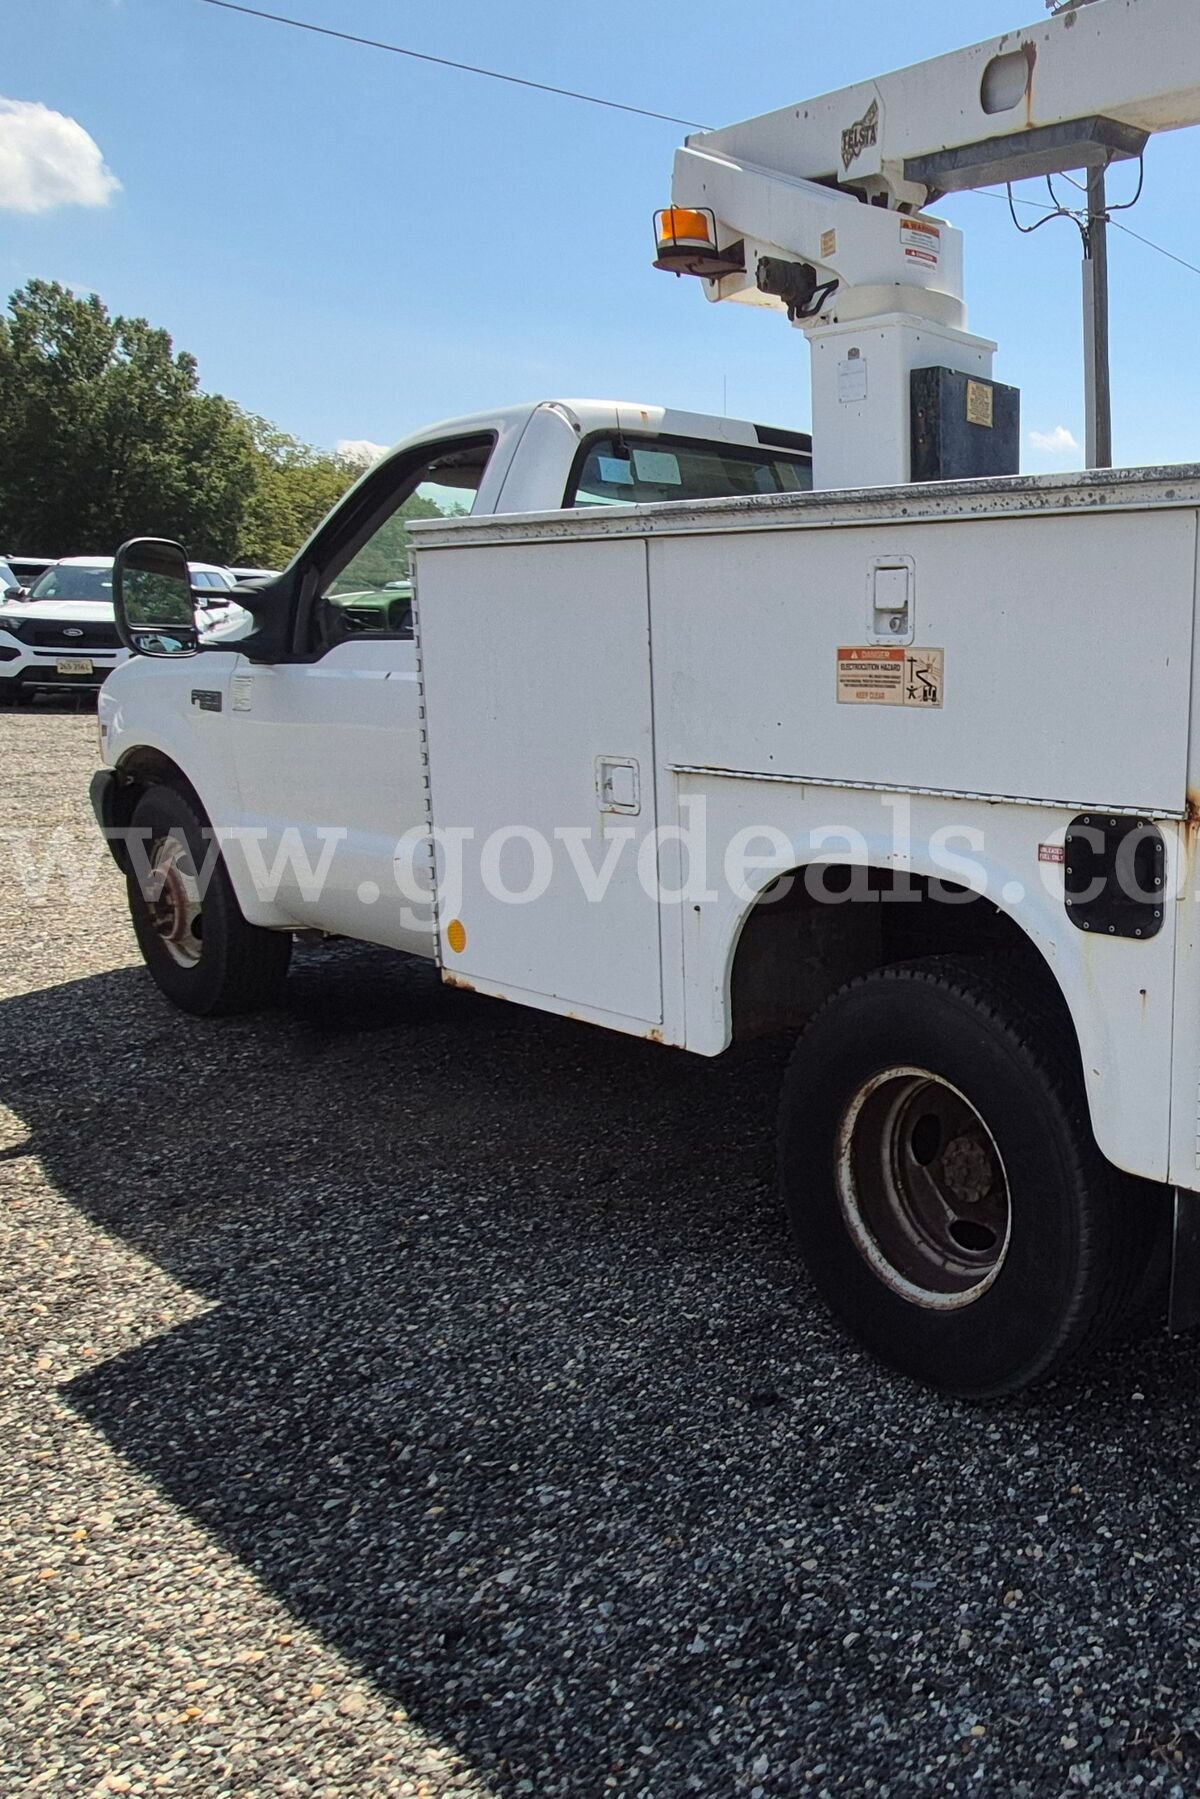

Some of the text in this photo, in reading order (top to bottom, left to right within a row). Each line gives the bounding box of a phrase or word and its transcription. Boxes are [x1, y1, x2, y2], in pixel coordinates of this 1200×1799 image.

[842, 125, 878, 151] TELSTA
[861, 650, 890, 659] DANGER
[840, 663, 901, 672] ELECTROCUTION HAZARD
[1040, 847, 1063, 855] UNLEADED
